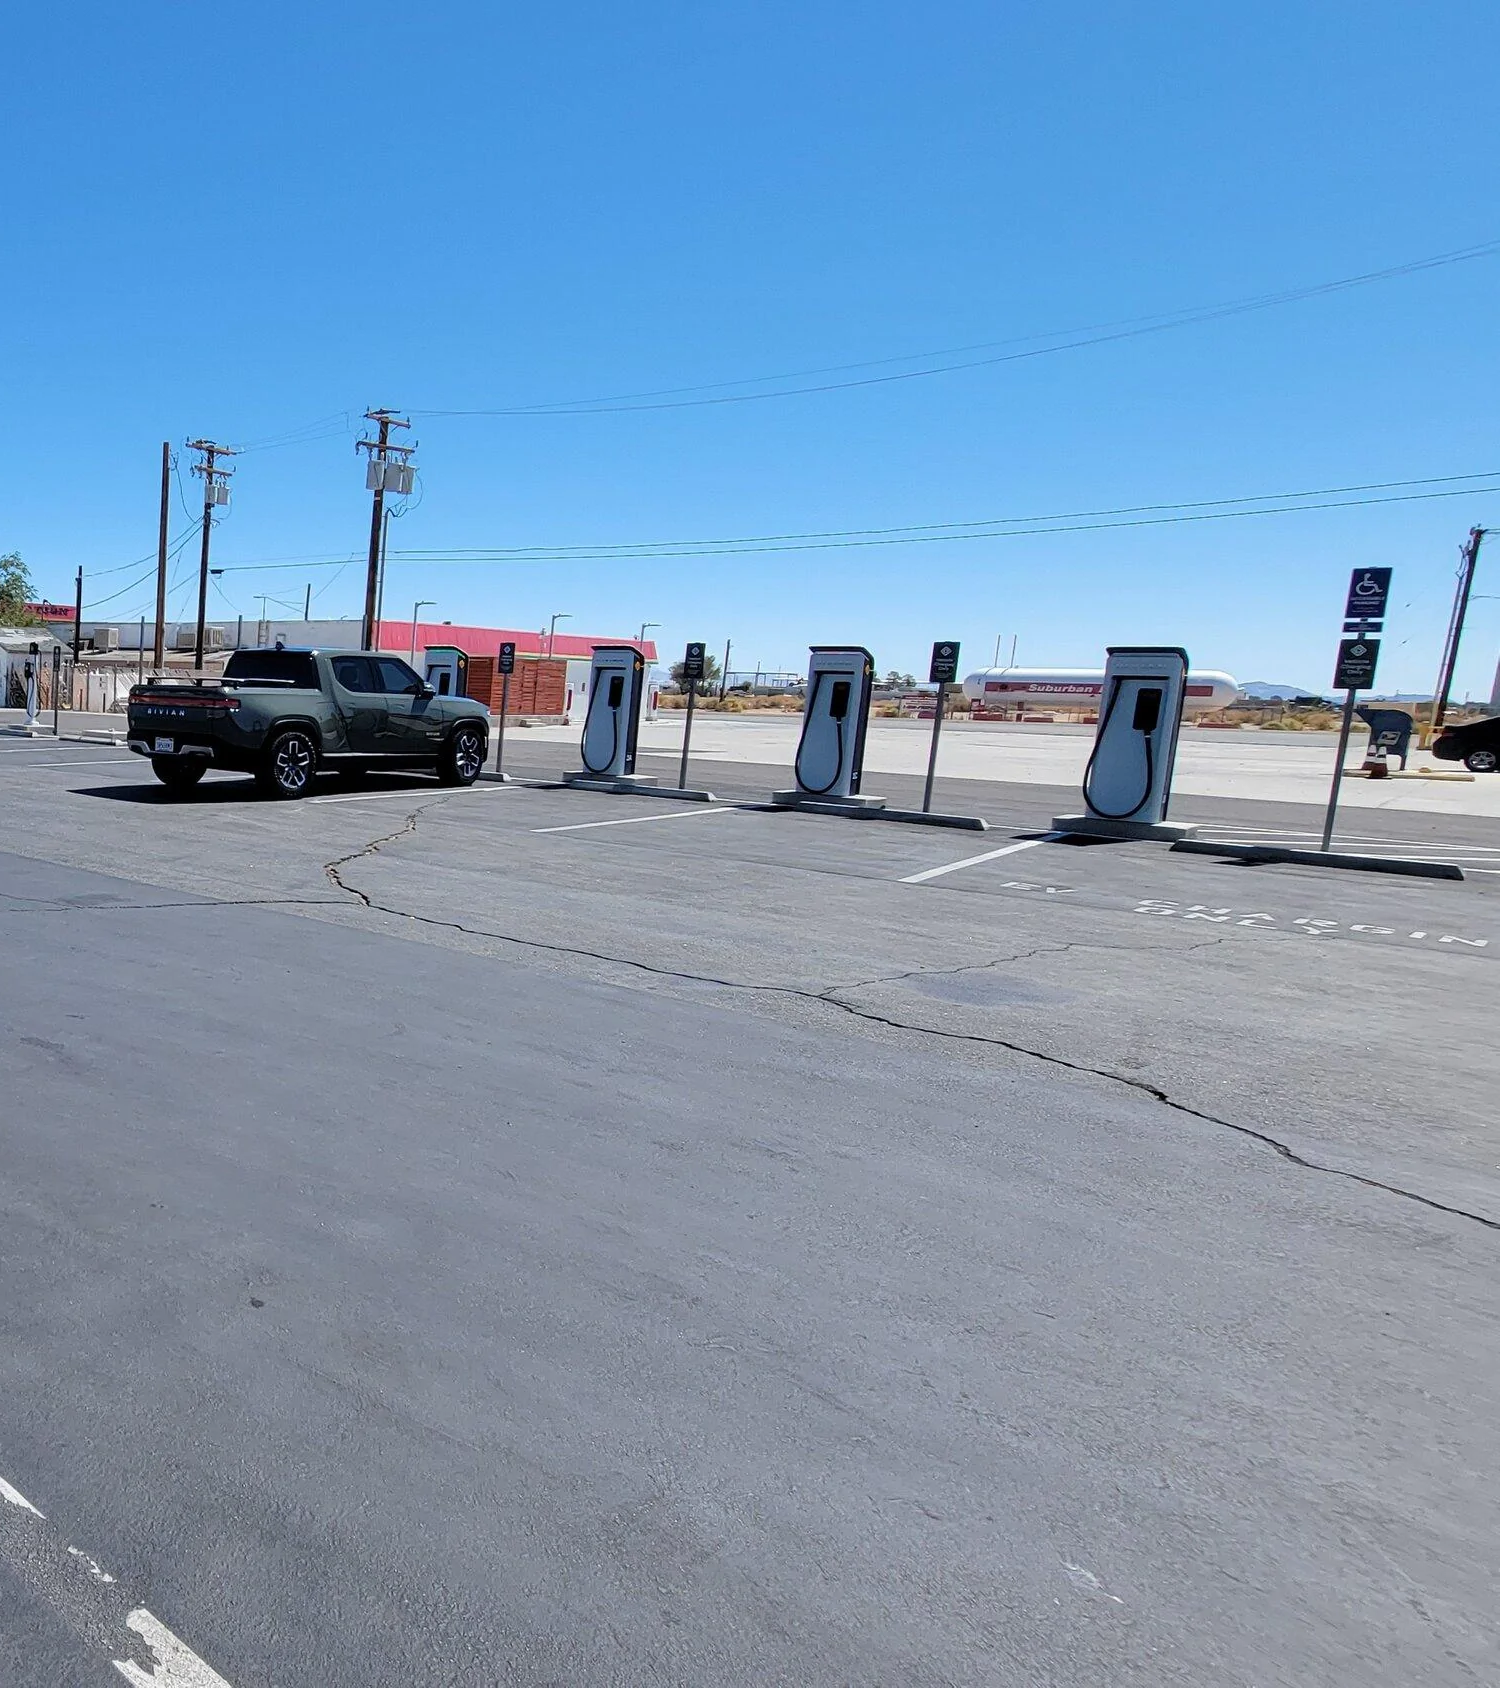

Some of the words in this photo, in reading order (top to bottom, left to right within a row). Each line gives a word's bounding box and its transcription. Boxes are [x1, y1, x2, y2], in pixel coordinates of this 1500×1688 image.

[1028, 683, 1093, 693] Suburban
[147, 707, 185, 716] RIVIAN
[1000, 881, 1078, 894] EV
[1138, 899, 1489, 948] CHARGIN
[1133, 906, 1340, 935] ONLY
